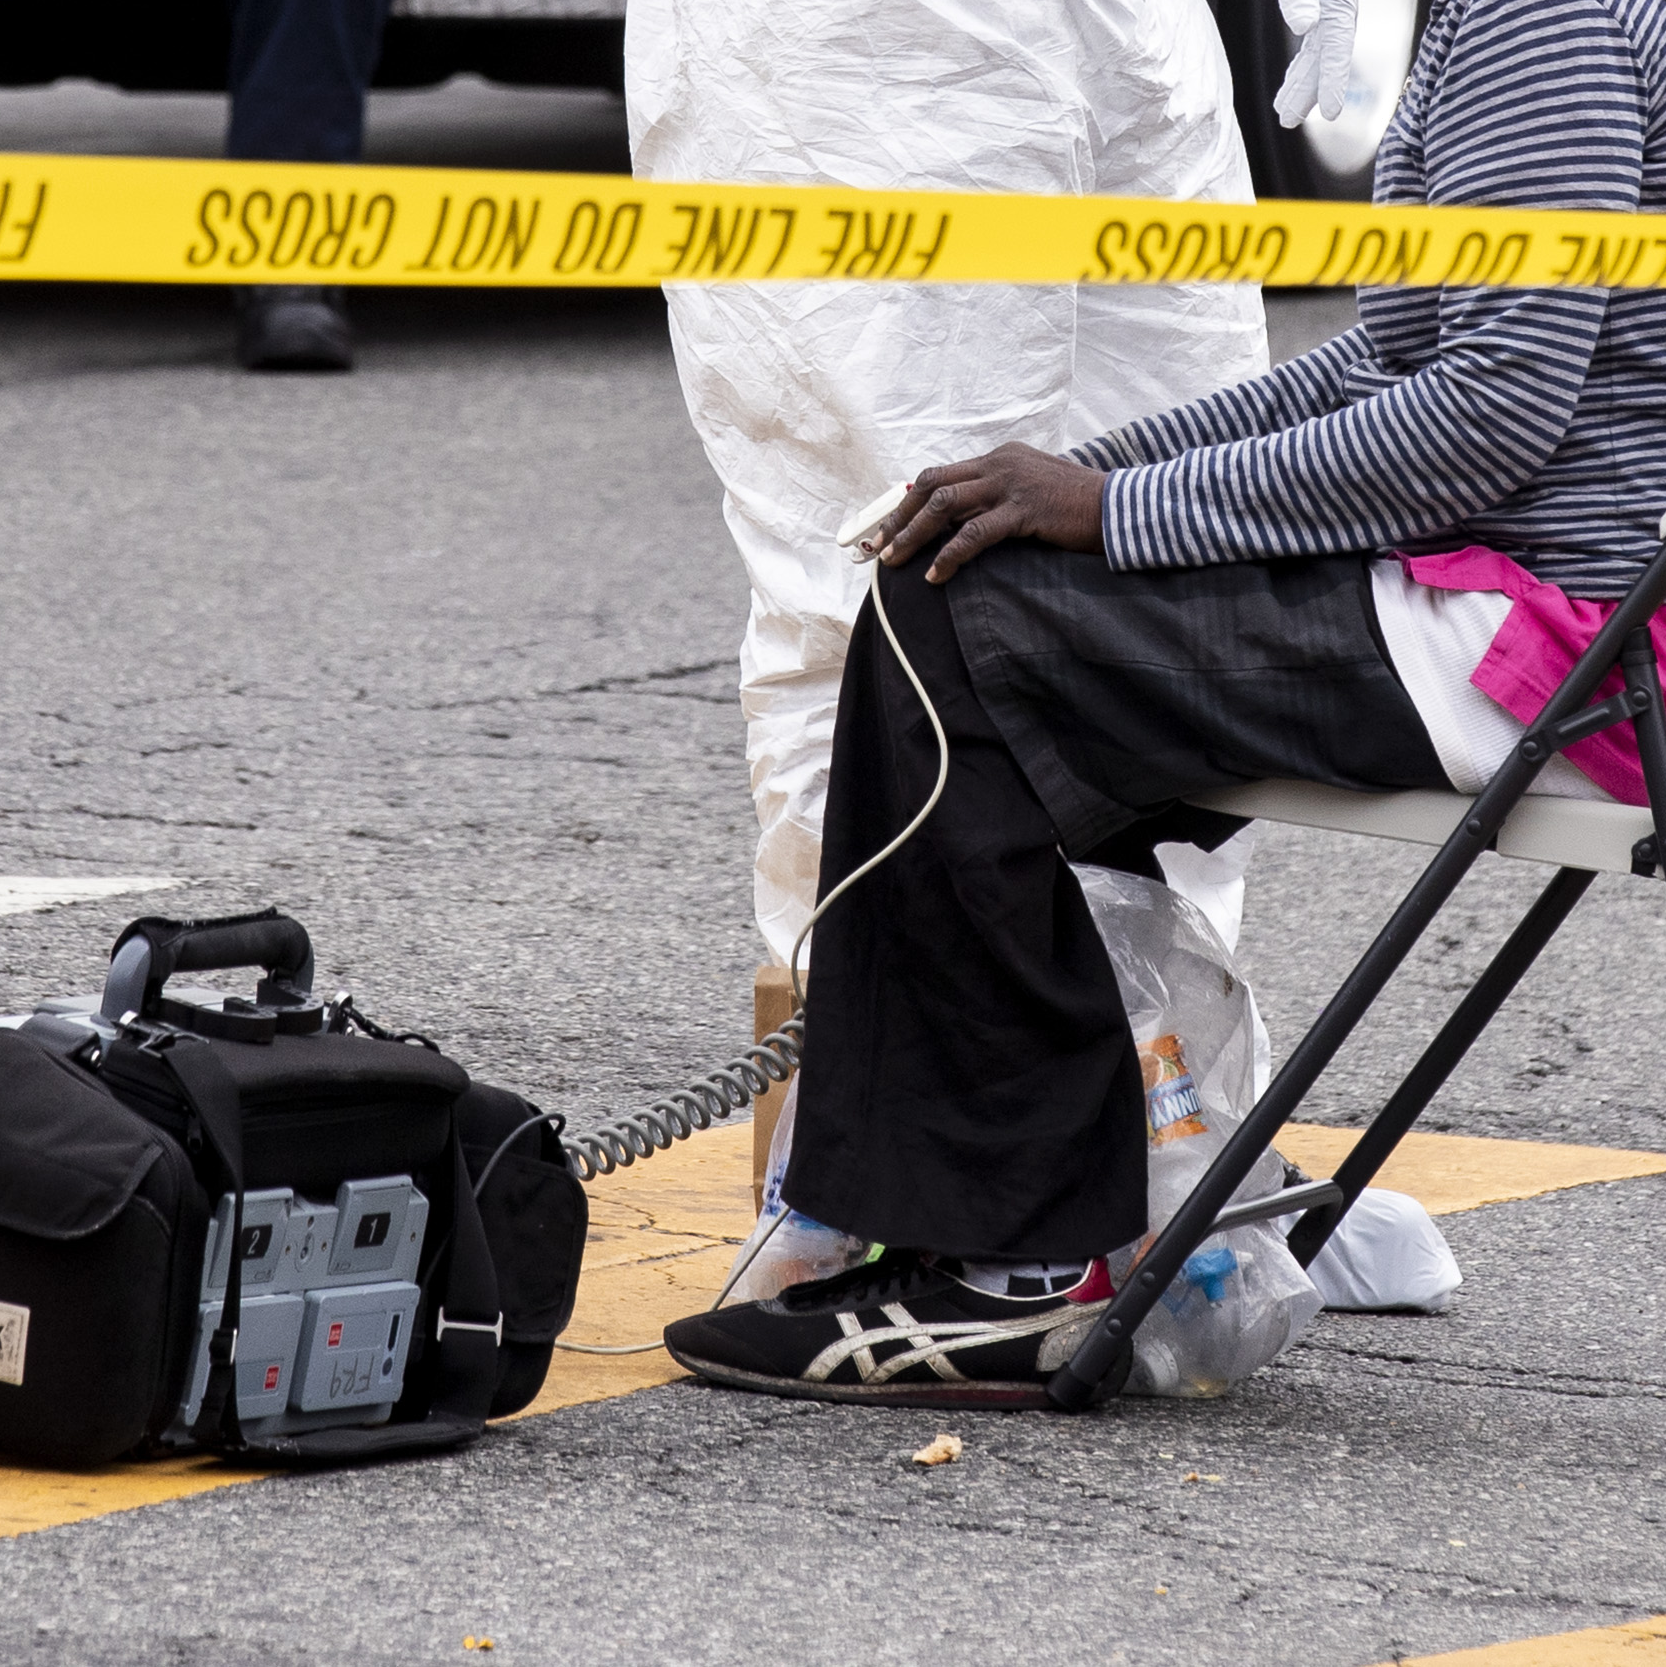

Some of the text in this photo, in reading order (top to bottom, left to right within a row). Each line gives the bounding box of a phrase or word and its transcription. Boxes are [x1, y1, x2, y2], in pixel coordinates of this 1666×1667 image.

[183, 187, 954, 280] FIRE LINE DO NOT CROSS
[246, 1228, 261, 1256] 2
[368, 1218, 378, 1243] 1
